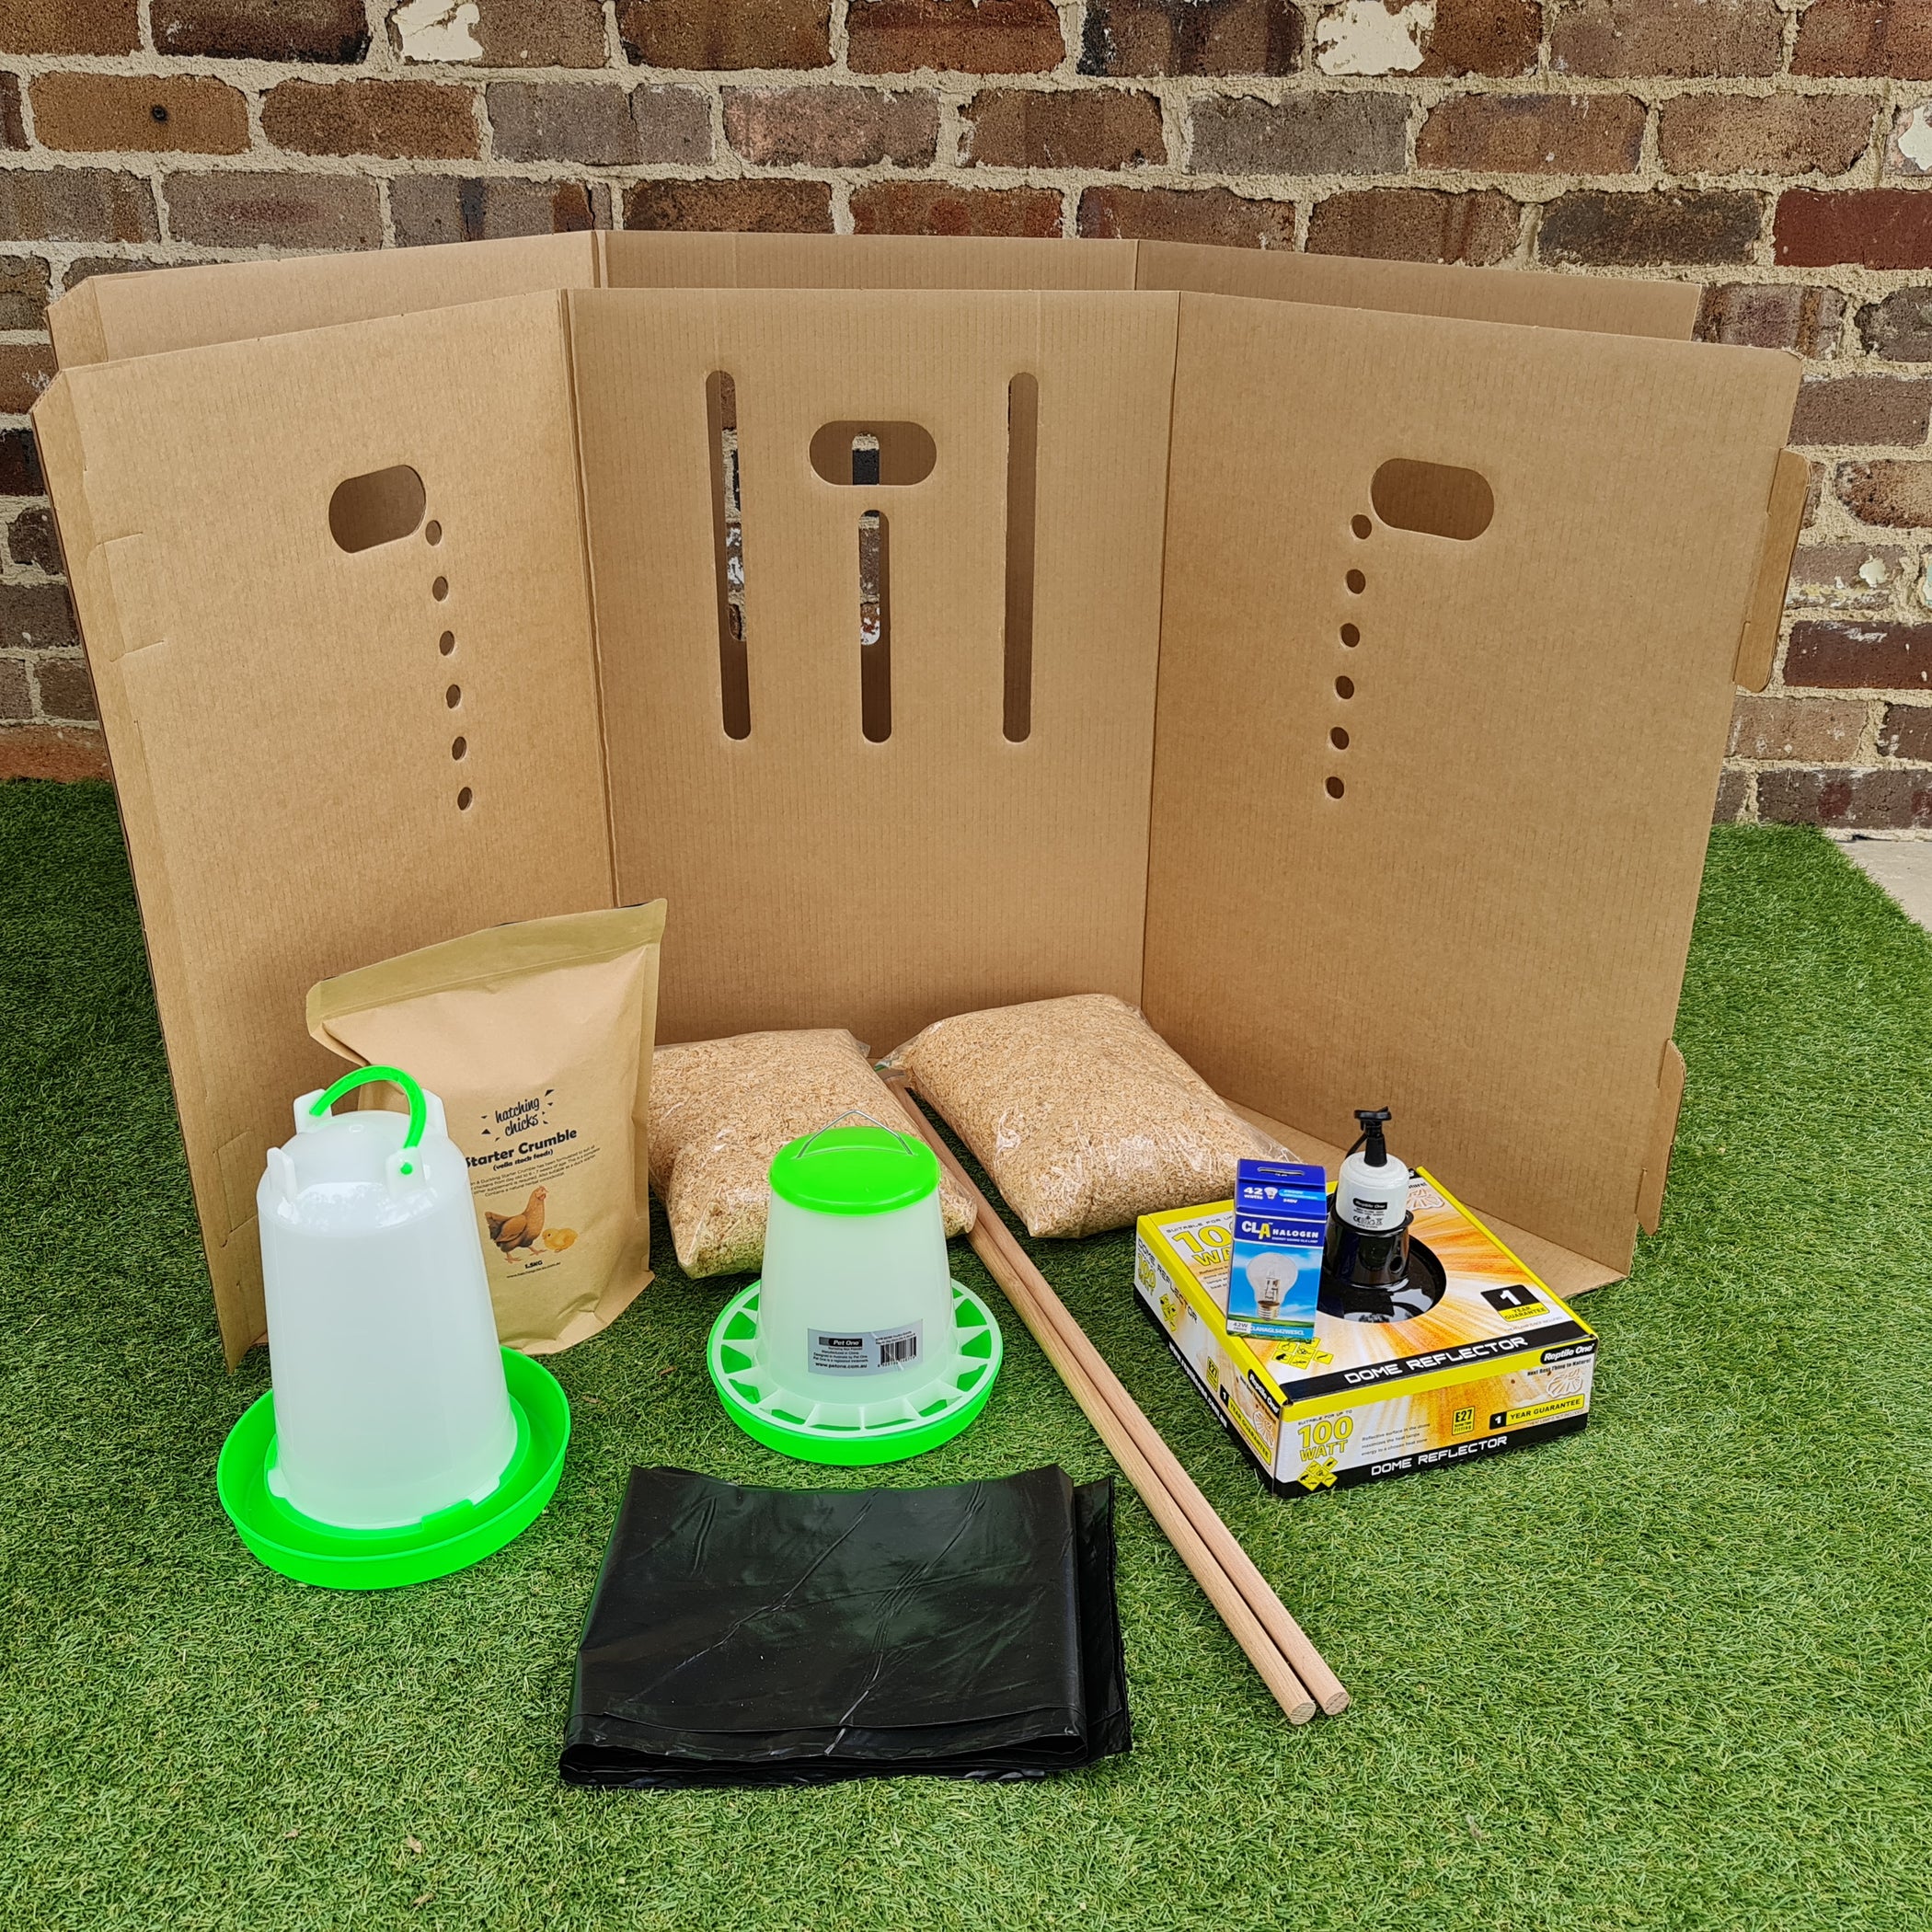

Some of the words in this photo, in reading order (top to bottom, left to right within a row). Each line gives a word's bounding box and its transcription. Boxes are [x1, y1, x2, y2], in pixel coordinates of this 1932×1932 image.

[495, 1098, 540, 1123] hatching
[505, 1114, 539, 1136] chicks
[518, 1129, 577, 1154] Crumble
[1243, 1187, 1263, 1195] 42
[1166, 1223, 1203, 1233] SUITABLE
[1171, 1222, 1232, 1253] 10
[1273, 1228, 1319, 1238] HALOGEN
[1500, 1289, 1521, 1306] 1
[1505, 1307, 1546, 1319] GUARANTEE
[1344, 1364, 1400, 1383] DOME
[1406, 1336, 1528, 1370] REFLECTOR
[1544, 1349, 1574, 1361] Reptile
[1250, 1373, 1267, 1400] Reptile
[1298, 1416, 1322, 1426] SUITABLE
[1455, 1409, 1472, 1422] E27
[1495, 1415, 1502, 1424] 1
[1510, 1411, 1531, 1420] YEAR
[1533, 1399, 1581, 1414] GUARANTEE
[1298, 1415, 1354, 1448] 100
[1299, 1440, 1348, 1462] WATT
[1371, 1458, 1412, 1476] DOME
[1418, 1436, 1508, 1465] REFLECTOR
